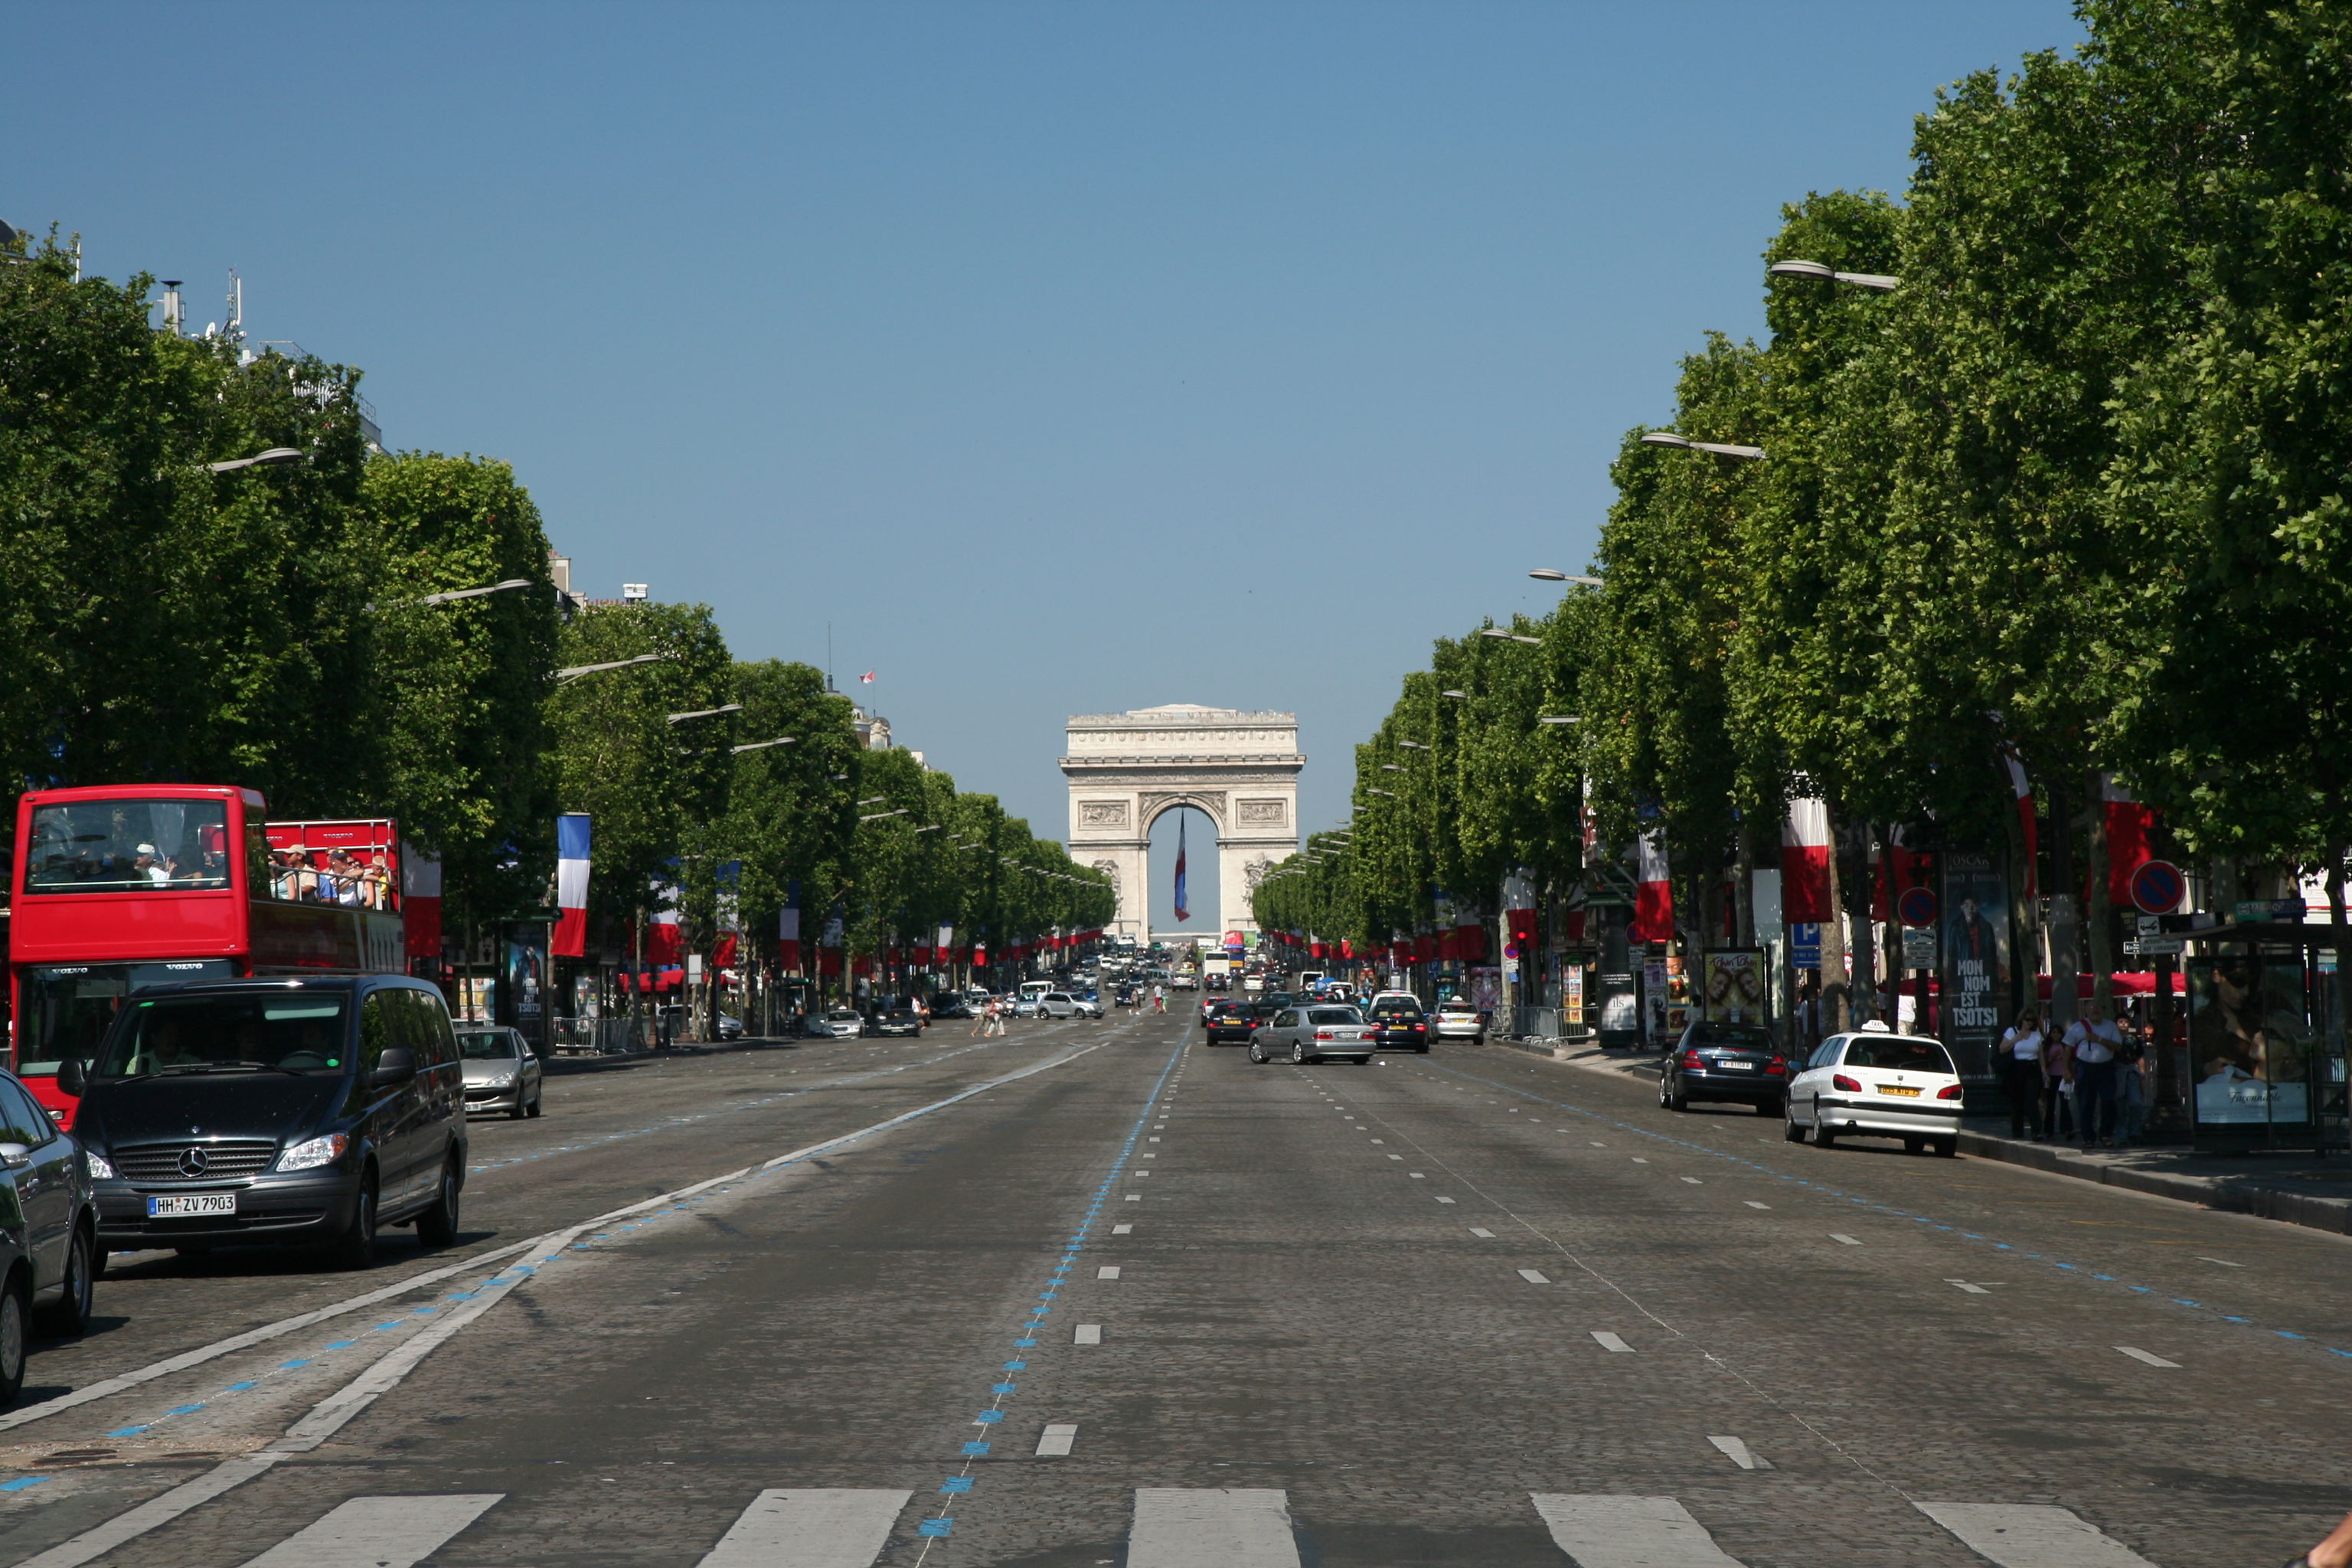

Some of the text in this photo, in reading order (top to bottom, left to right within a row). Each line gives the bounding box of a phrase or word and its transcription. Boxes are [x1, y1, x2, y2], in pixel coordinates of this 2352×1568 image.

[1803, 922, 1818, 941] P
[1958, 959, 1983, 976] MON
[1965, 975, 1990, 991] NOM
[1961, 991, 1981, 1007] EST
[1953, 1007, 1998, 1027] TSOTSI
[158, 1196, 234, 1212] HH ZV 7903
